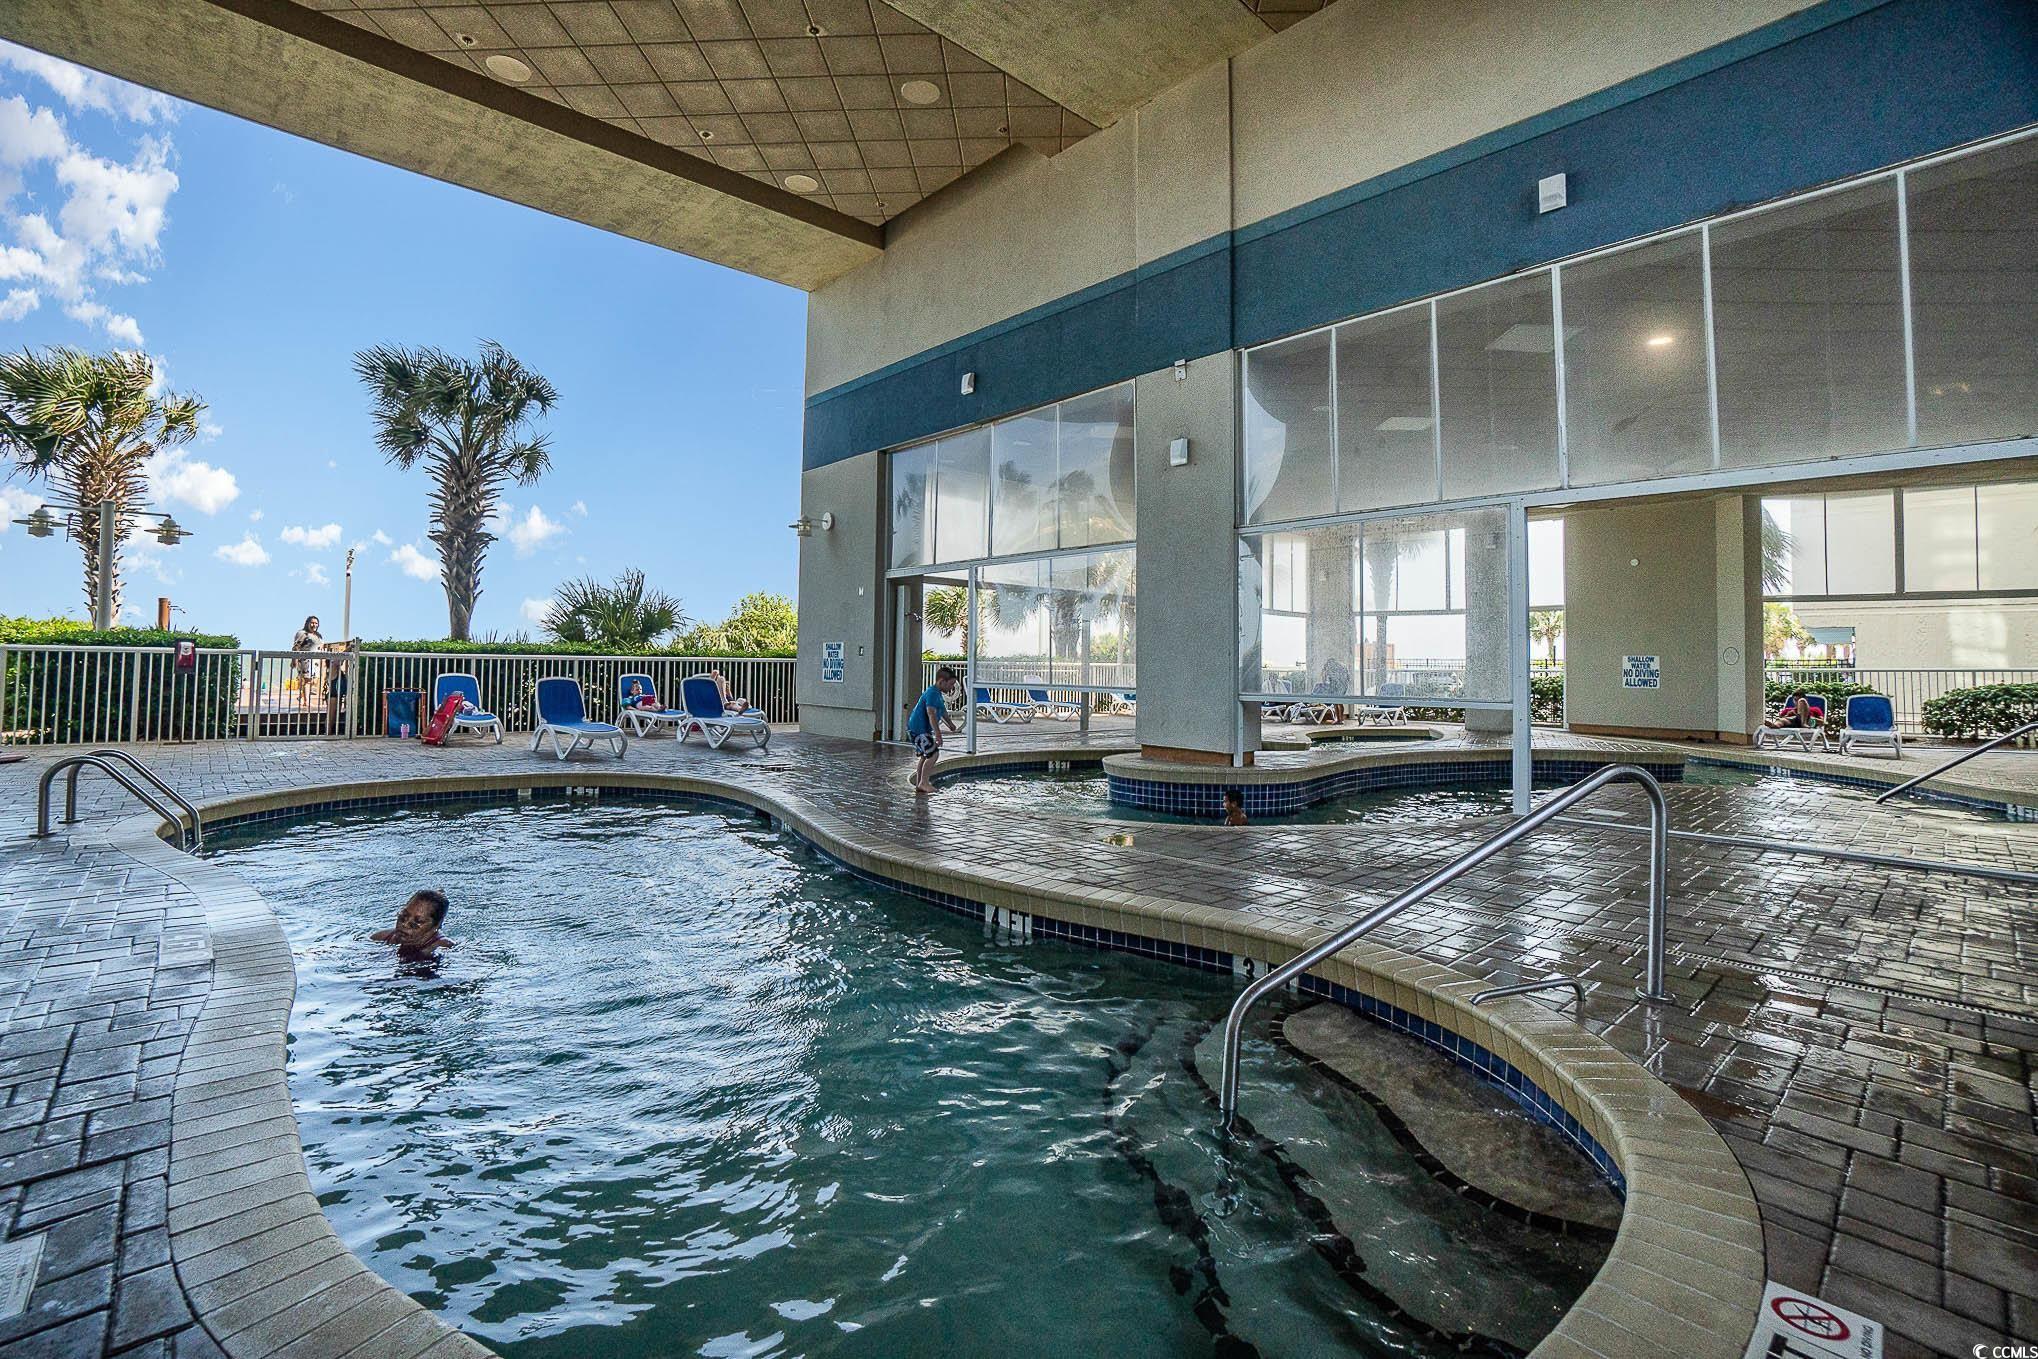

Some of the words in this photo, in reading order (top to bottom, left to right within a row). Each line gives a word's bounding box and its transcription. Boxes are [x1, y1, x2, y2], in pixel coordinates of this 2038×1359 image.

[1631, 662, 1651, 670] WATER
[1623, 668, 1634, 678] NO
[1634, 669, 1660, 679] DIVING
[1624, 678, 1658, 688] ALLOWED
[1009, 909, 1030, 933] FT
[1861, 1325, 1874, 1349] DIVING
